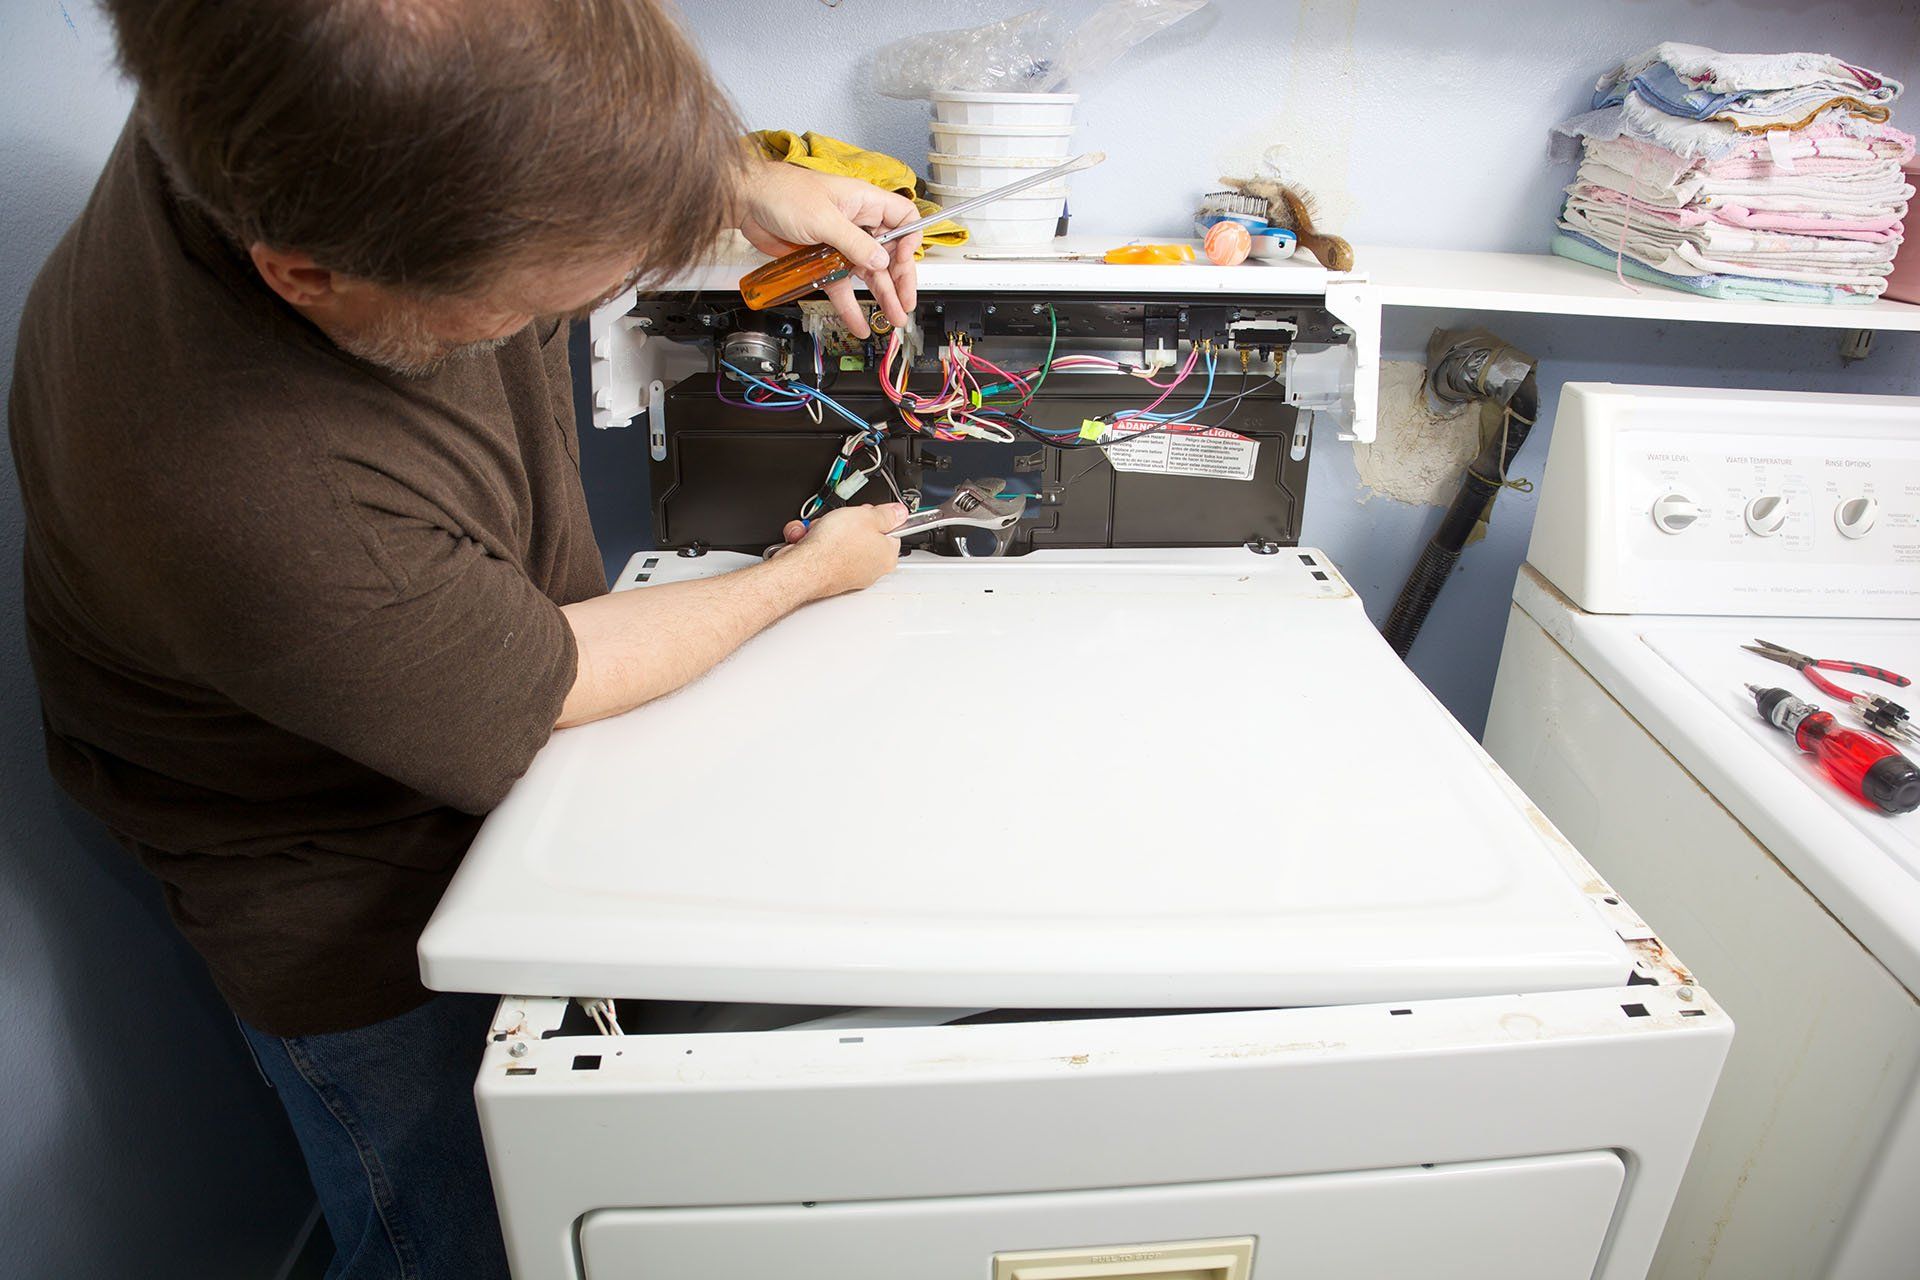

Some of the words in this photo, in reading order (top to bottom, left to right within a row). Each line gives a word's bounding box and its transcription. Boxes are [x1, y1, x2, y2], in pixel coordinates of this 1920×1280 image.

[1726, 456, 1748, 464] WATER
[1750, 457, 1793, 466] TEMPERATURE
[1825, 459, 1843, 467] RINSE
[1844, 460, 1872, 469] OPTIONS
